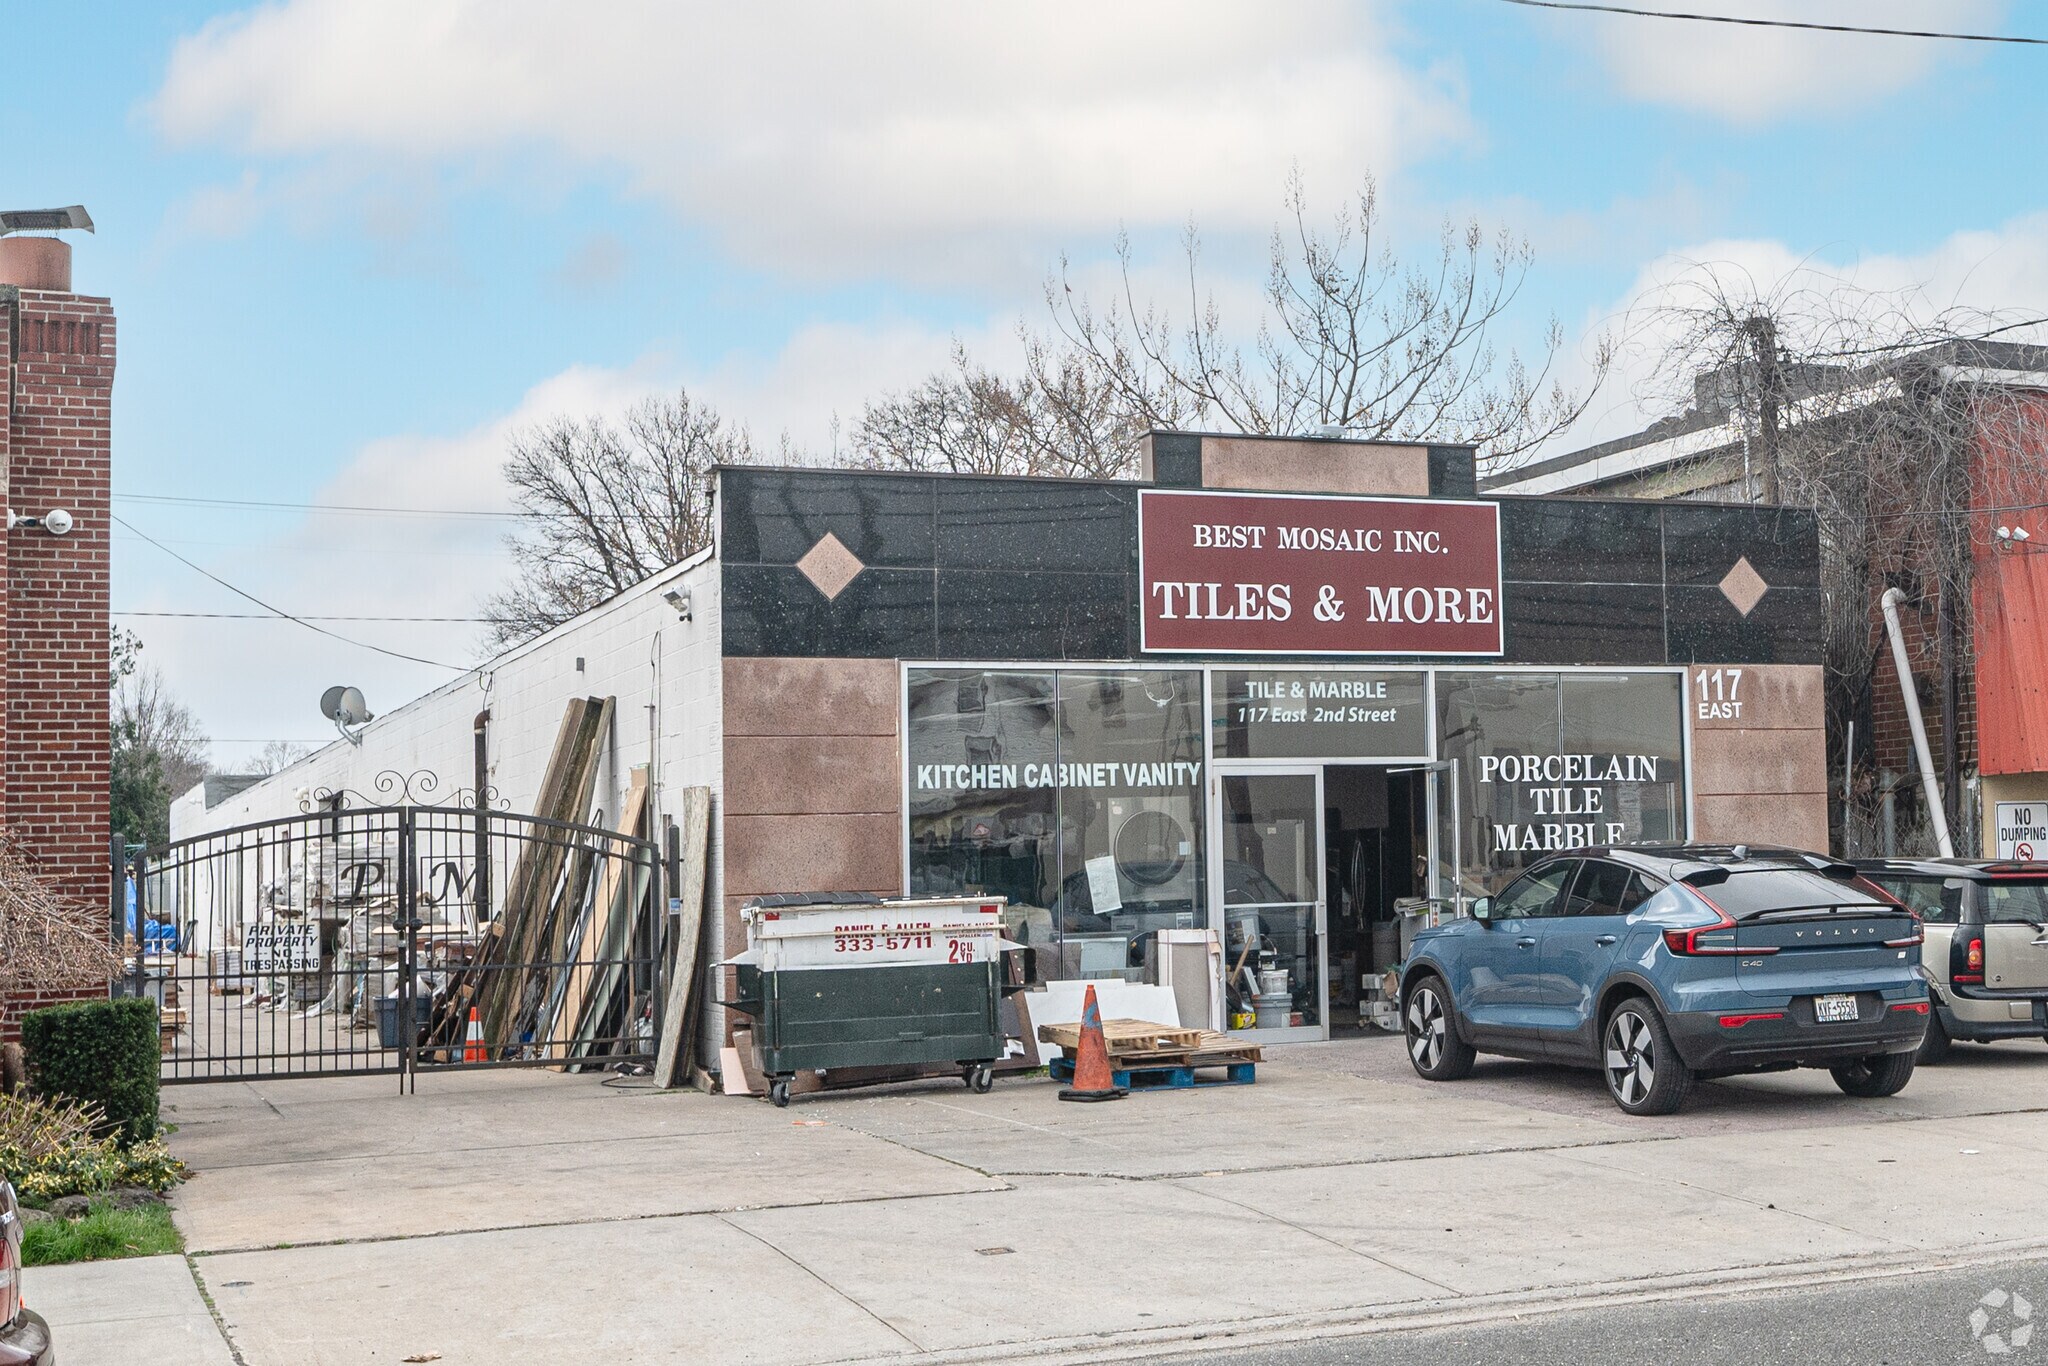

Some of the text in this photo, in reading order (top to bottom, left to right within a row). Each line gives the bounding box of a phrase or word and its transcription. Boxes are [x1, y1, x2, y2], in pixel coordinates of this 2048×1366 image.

[1193, 524, 1449, 554] BEST MOSAIC INC.
[1152, 581, 1493, 624] TILES & MORE
[1245, 681, 1387, 699] TILE & MARBLE
[1696, 669, 1742, 701] 117
[1238, 707, 1397, 723] 117 East 2nd Street
[1698, 701, 1743, 719] EAST
[917, 762, 1201, 789] KITCHEN CABINET VANITY
[1479, 754, 1659, 782] PORCELAIN
[1530, 787, 1604, 815] TILE
[2014, 808, 2031, 825] NO
[1494, 823, 1625, 851] MARBLE
[2001, 826, 2047, 841] DUMPING
[249, 924, 315, 936] PRIVATE
[1796, 927, 1874, 938] VOLVO
[245, 936, 318, 948] PROPERTY
[834, 936, 932, 952] 333-5711
[272, 948, 292, 958] NO
[948, 939, 959, 964] 2
[960, 952, 973, 964] YD
[244, 958, 319, 970] TRESPASSING
